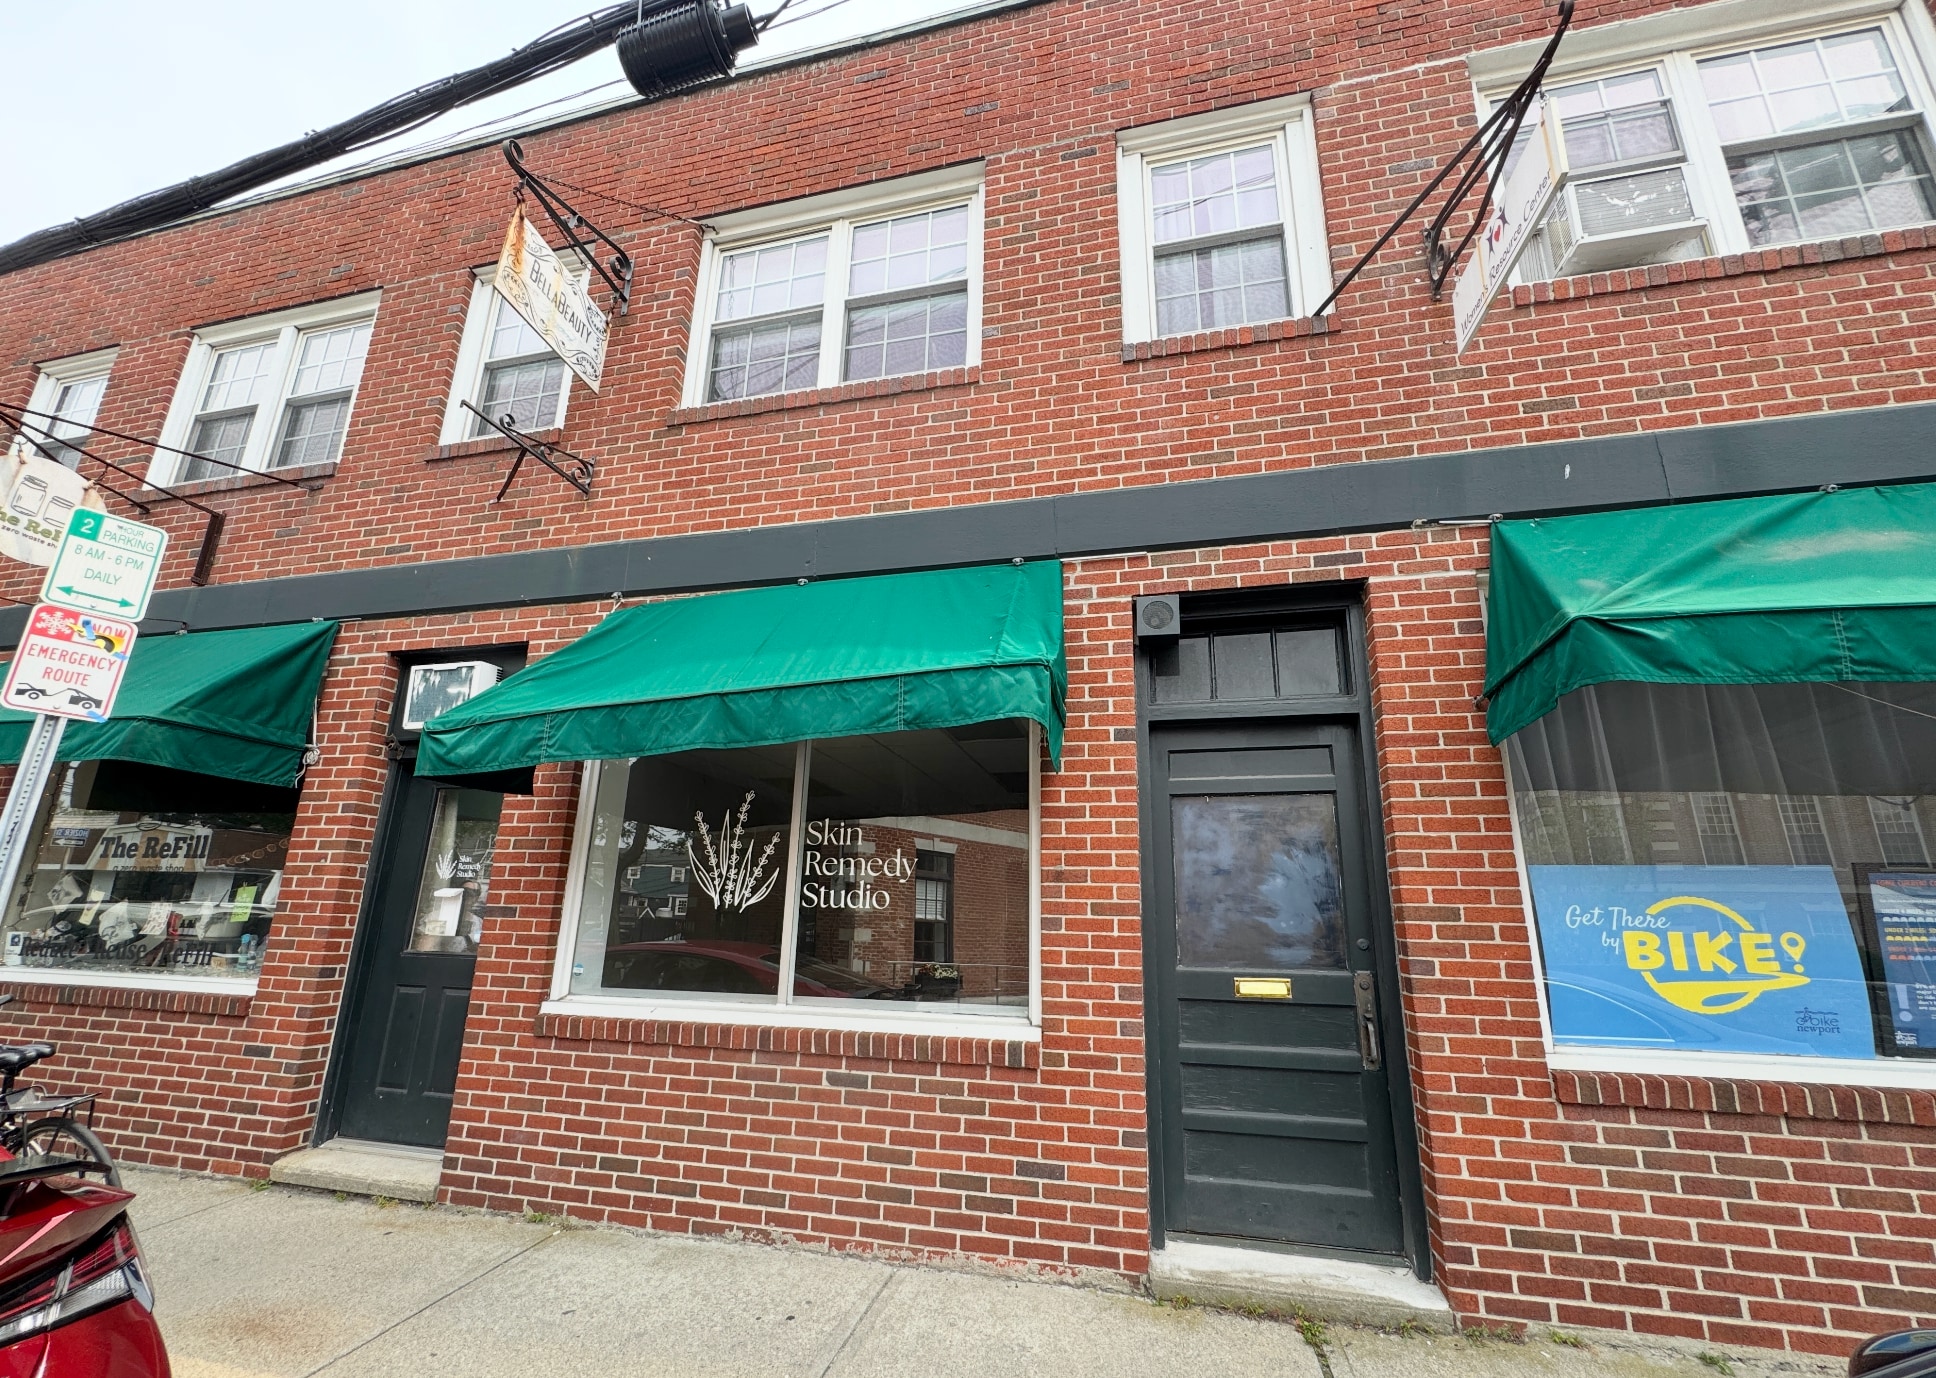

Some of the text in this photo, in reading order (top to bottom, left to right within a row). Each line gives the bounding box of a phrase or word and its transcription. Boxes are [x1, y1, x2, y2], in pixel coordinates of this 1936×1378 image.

[1489, 223, 1522, 286] Resource
[1523, 168, 1551, 222] Center
[1, 525, 20, 535] zero
[22, 532, 46, 545] waste
[80, 518, 95, 534] 2
[102, 530, 155, 553] PARKING
[74, 544, 84, 555] 8
[85, 547, 106, 561] AM
[114, 555, 123, 566] 6
[125, 557, 145, 571] PM
[83, 567, 123, 586] DAILY
[89, 622, 128, 639] NOW
[27, 643, 118, 672] EMERGENCY
[42, 666, 92, 687] ROUTE
[806, 818, 863, 846] Skin
[100, 834, 210, 859] The ReFill
[804, 847, 919, 884] Remedy
[801, 879, 890, 910] Studio
[1565, 904, 1671, 931] Get There
[92, 938, 148, 961] Reuse
[1601, 932, 1620, 955] by
[1797, 1025, 1842, 1036] newport
